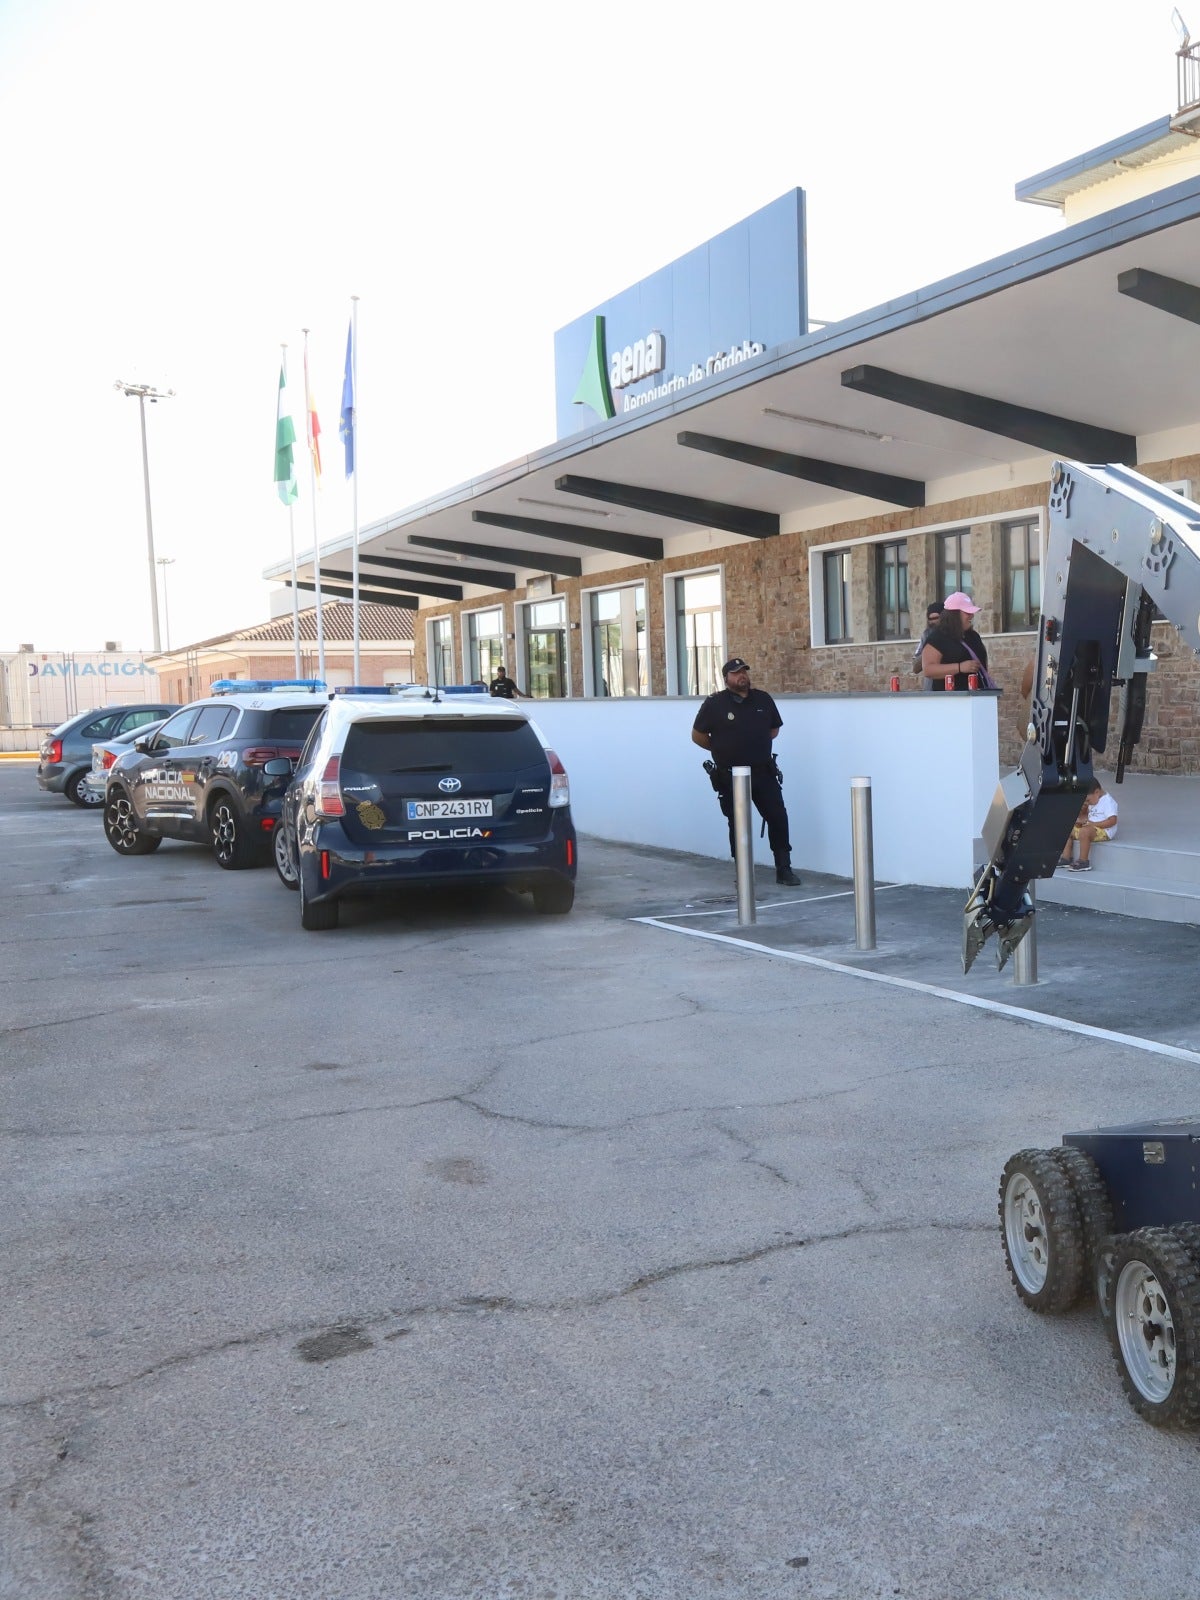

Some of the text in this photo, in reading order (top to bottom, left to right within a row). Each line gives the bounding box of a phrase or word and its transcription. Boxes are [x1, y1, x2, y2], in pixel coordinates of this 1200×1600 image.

[610, 330, 665, 389] aena
[144, 786, 196, 801] NACIONAL
[408, 827, 484, 841] POLICÍA
